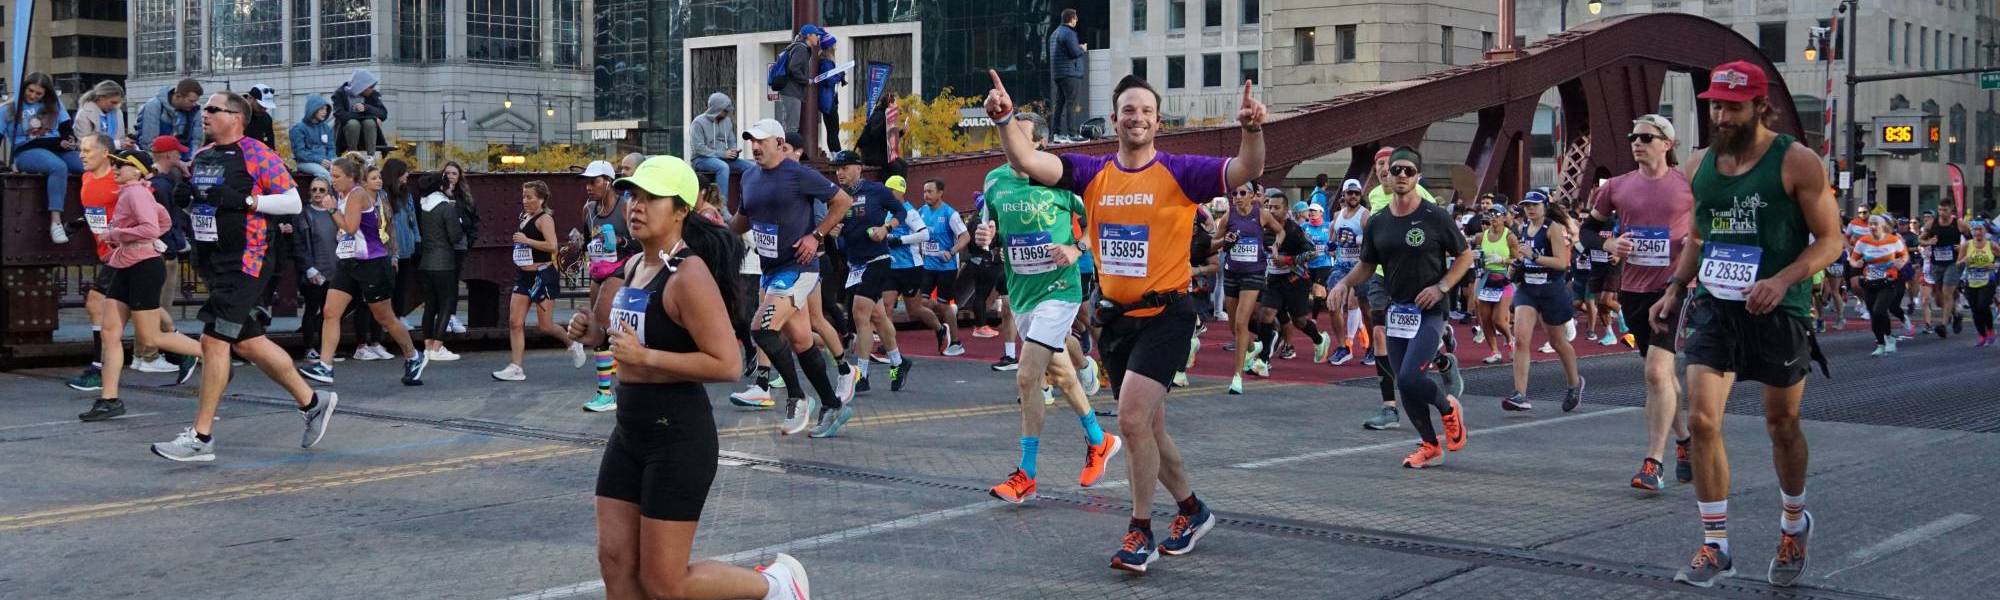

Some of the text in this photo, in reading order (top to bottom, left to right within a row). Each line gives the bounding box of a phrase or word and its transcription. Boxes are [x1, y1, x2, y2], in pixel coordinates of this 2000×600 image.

[591, 129, 626, 140] FLIGHT CLUB
[1885, 126, 1911, 142] 8:36
[1099, 193, 1154, 206] JEROEN
[1709, 208, 1731, 217] Team
[1711, 218, 1757, 230] ChiParks
[1011, 245, 1052, 261] F 19692
[1101, 240, 1145, 259] H 35895
[1637, 240, 1666, 253] 25467
[1704, 260, 1753, 282] G 28335
[1397, 314, 1419, 326] 28855
